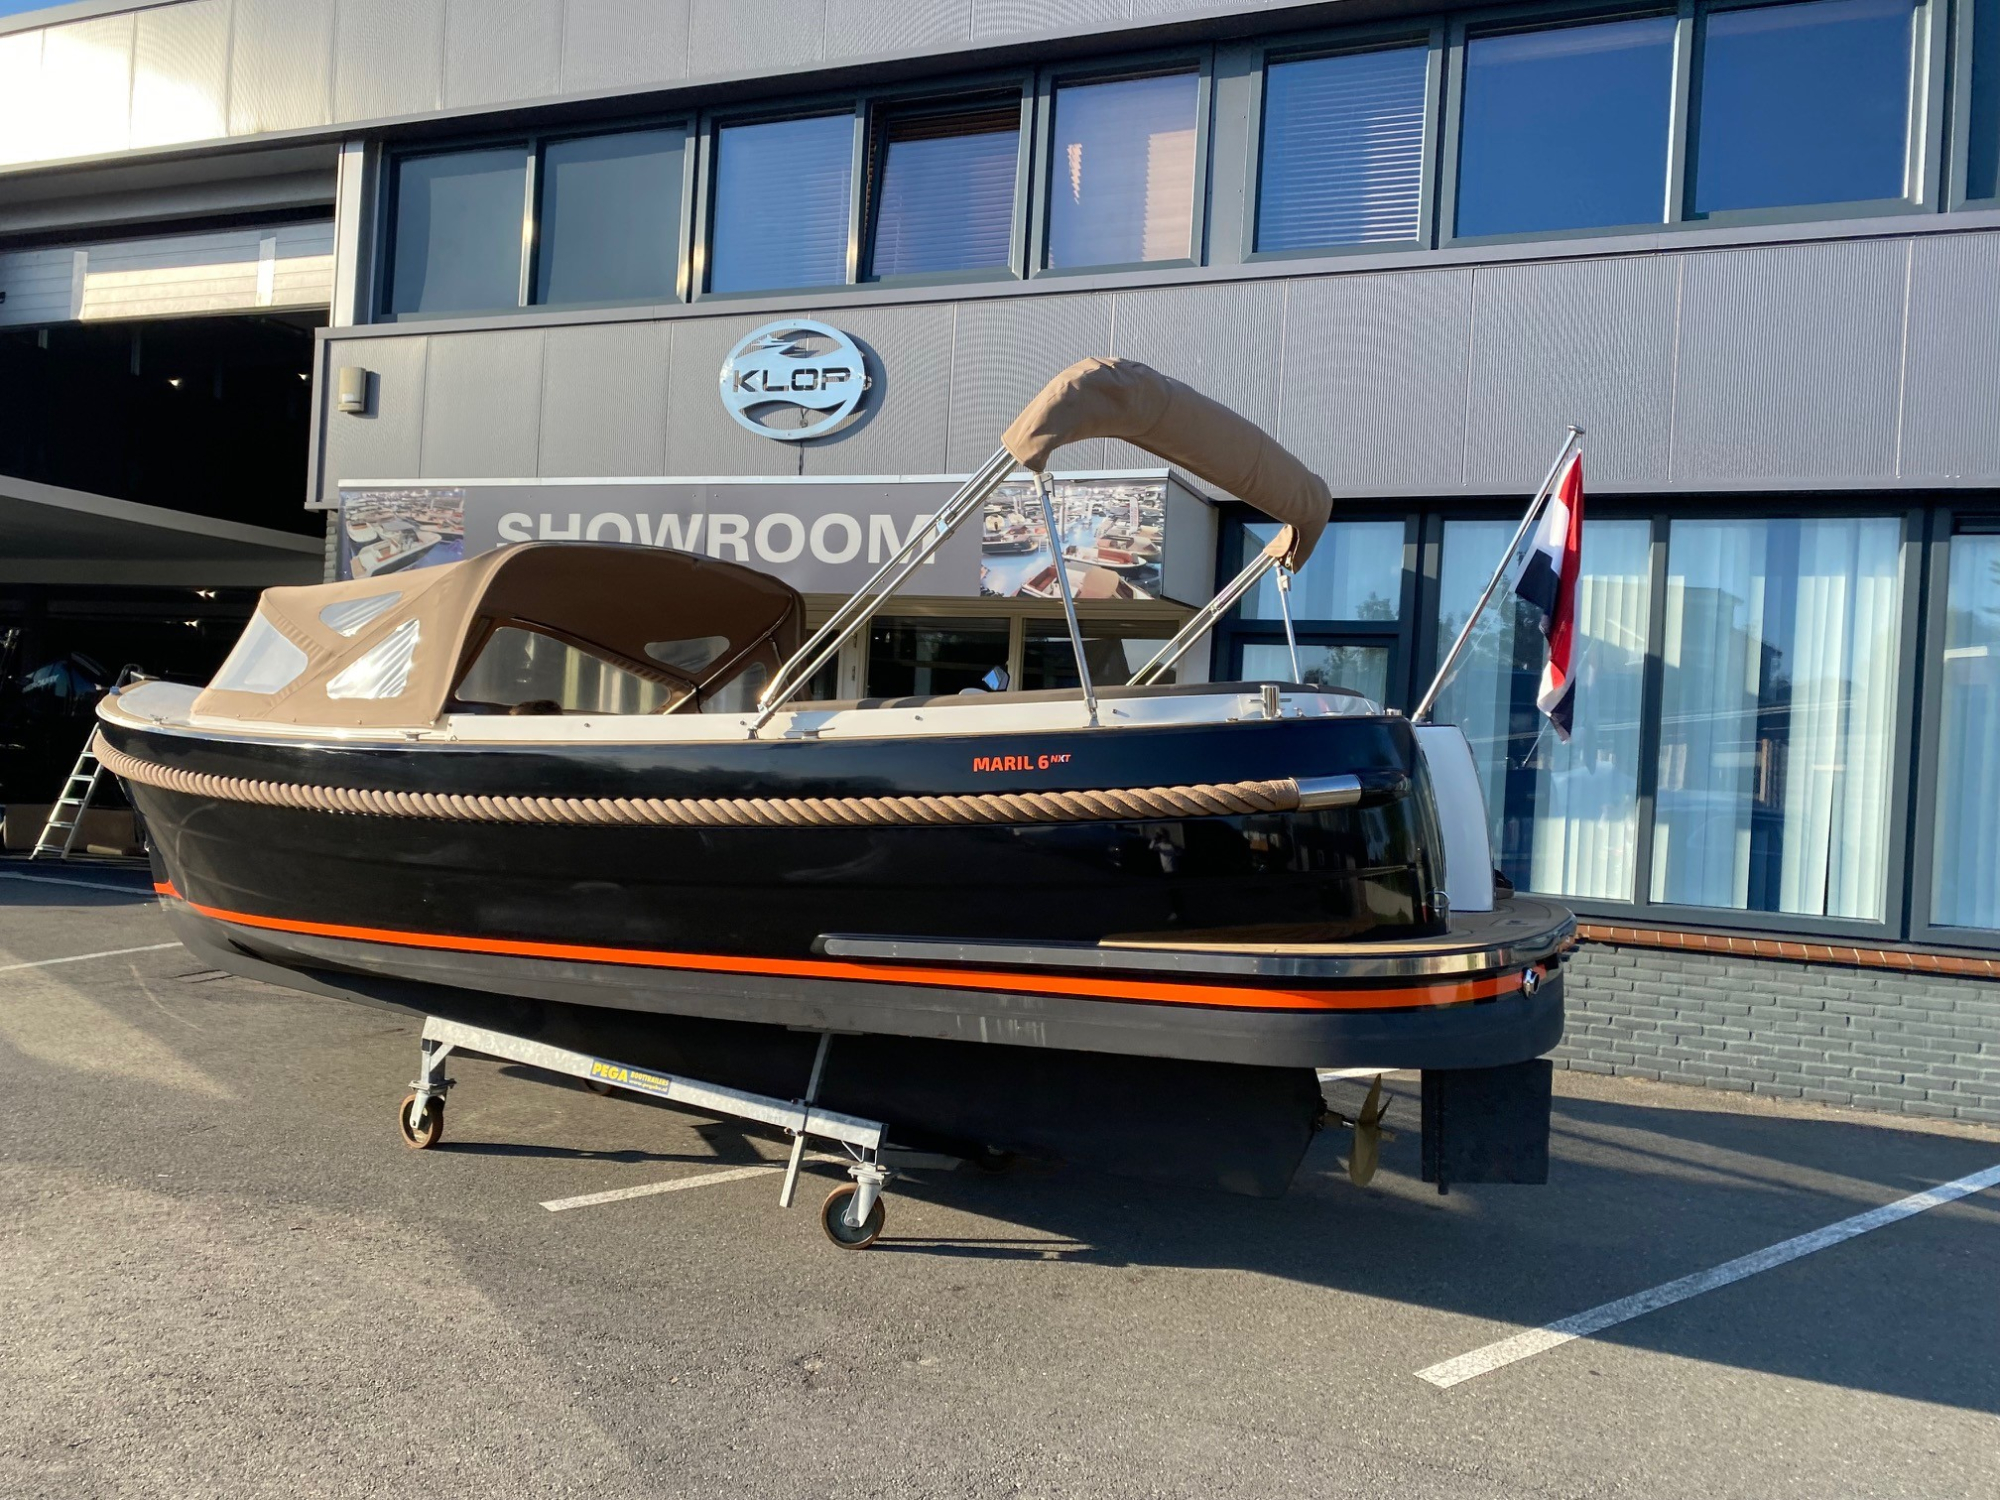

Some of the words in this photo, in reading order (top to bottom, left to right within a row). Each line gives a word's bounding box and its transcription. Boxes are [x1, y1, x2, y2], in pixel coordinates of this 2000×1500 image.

[732, 366, 851, 393] KLOP
[496, 512, 936, 565] SHOWROOM
[973, 755, 1034, 772] MARIL
[592, 1061, 628, 1083] PEGA
